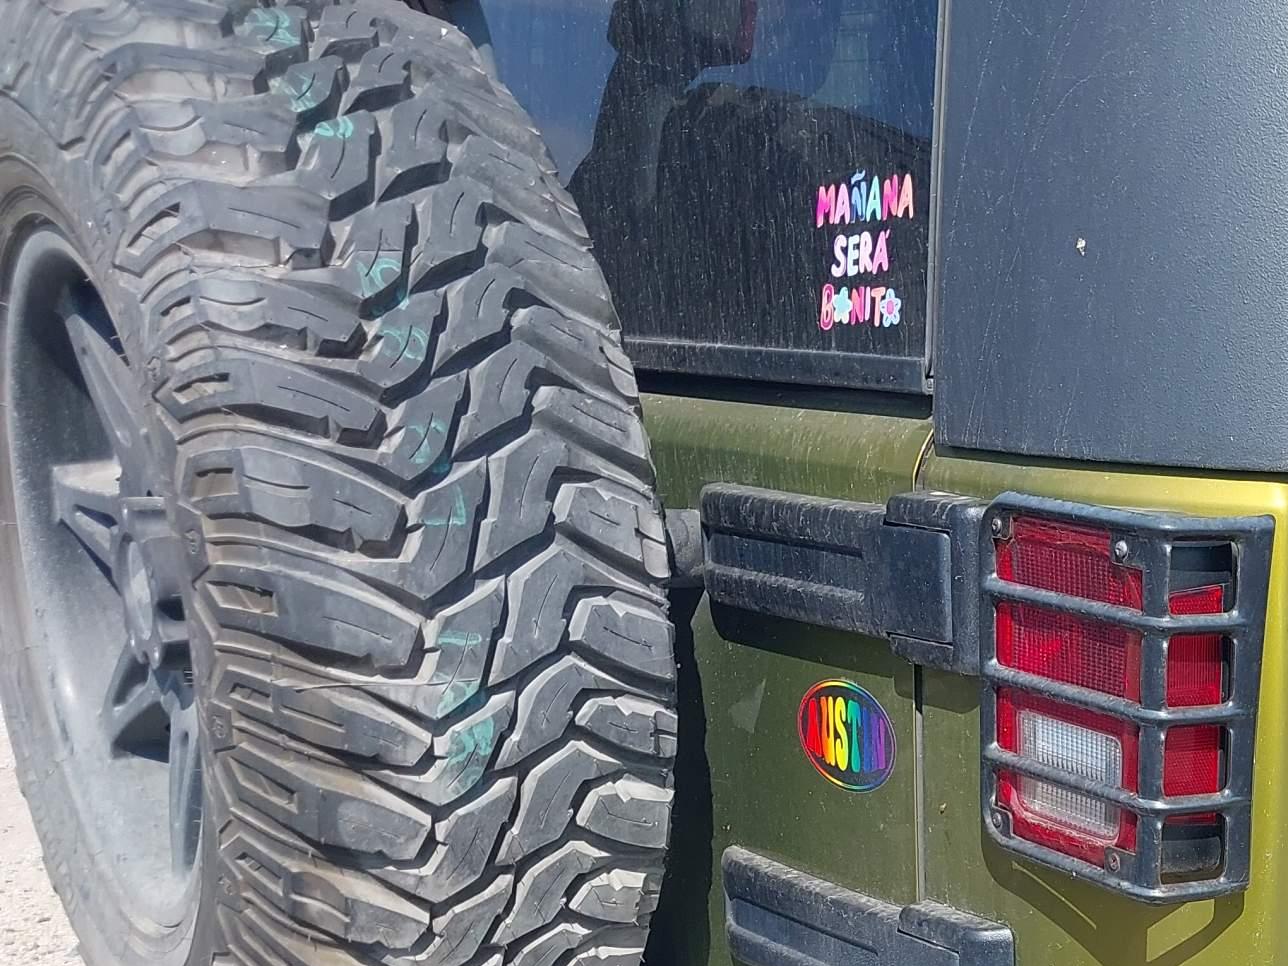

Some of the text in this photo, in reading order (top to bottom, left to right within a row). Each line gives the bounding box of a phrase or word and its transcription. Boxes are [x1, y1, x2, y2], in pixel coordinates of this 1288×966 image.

[816, 169, 914, 228] MAÑANA
[831, 229, 890, 278] SERÁ
[807, 696, 886, 773] AUSTIN
